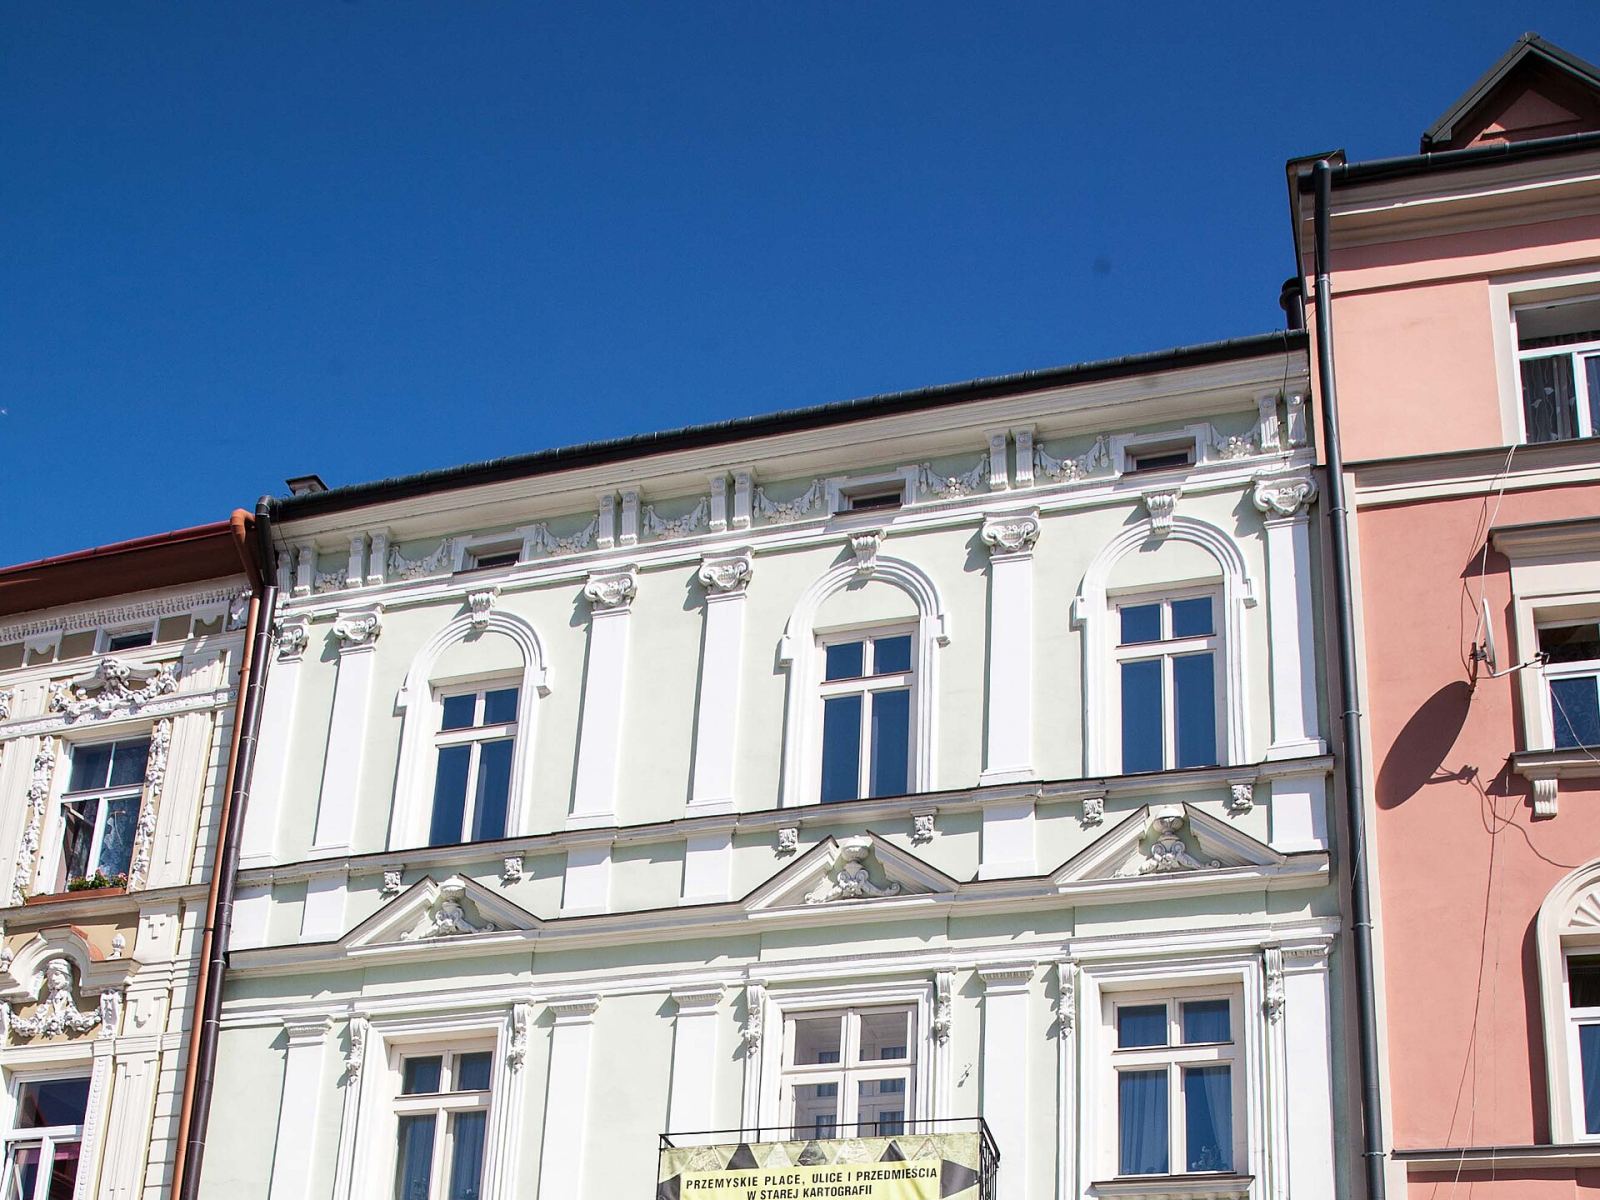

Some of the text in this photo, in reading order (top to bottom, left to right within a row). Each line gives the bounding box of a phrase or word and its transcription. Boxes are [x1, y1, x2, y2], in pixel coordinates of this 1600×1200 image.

[686, 1165, 937, 1190] PRZEMYSKIE PLACE, ULICE I PRZEDMIEŚCIA
[747, 1184, 872, 1200] W STAREJ KARTOGRAFII
